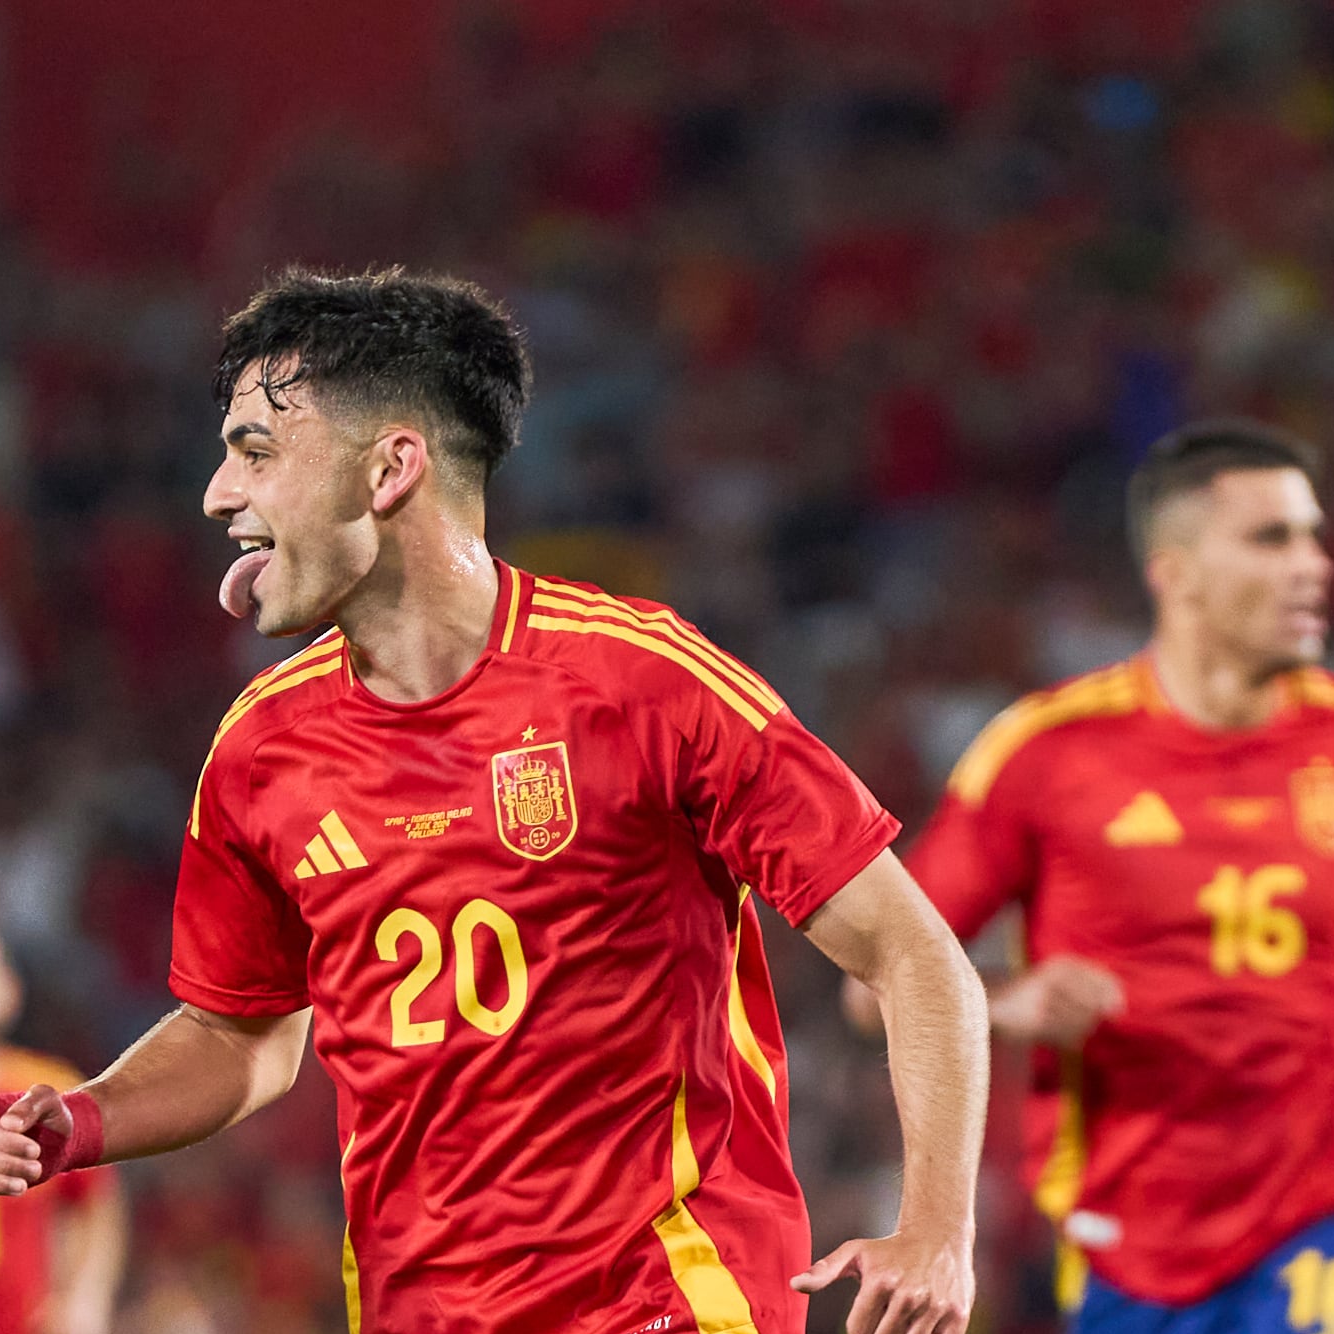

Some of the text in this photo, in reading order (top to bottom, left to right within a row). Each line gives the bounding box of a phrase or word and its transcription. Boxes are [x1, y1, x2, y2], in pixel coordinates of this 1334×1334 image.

[384, 816, 406, 827] SPAIN
[410, 811, 446, 824] NORTHERN
[374, 898, 529, 1048] 20
[1195, 863, 1308, 979] 16
